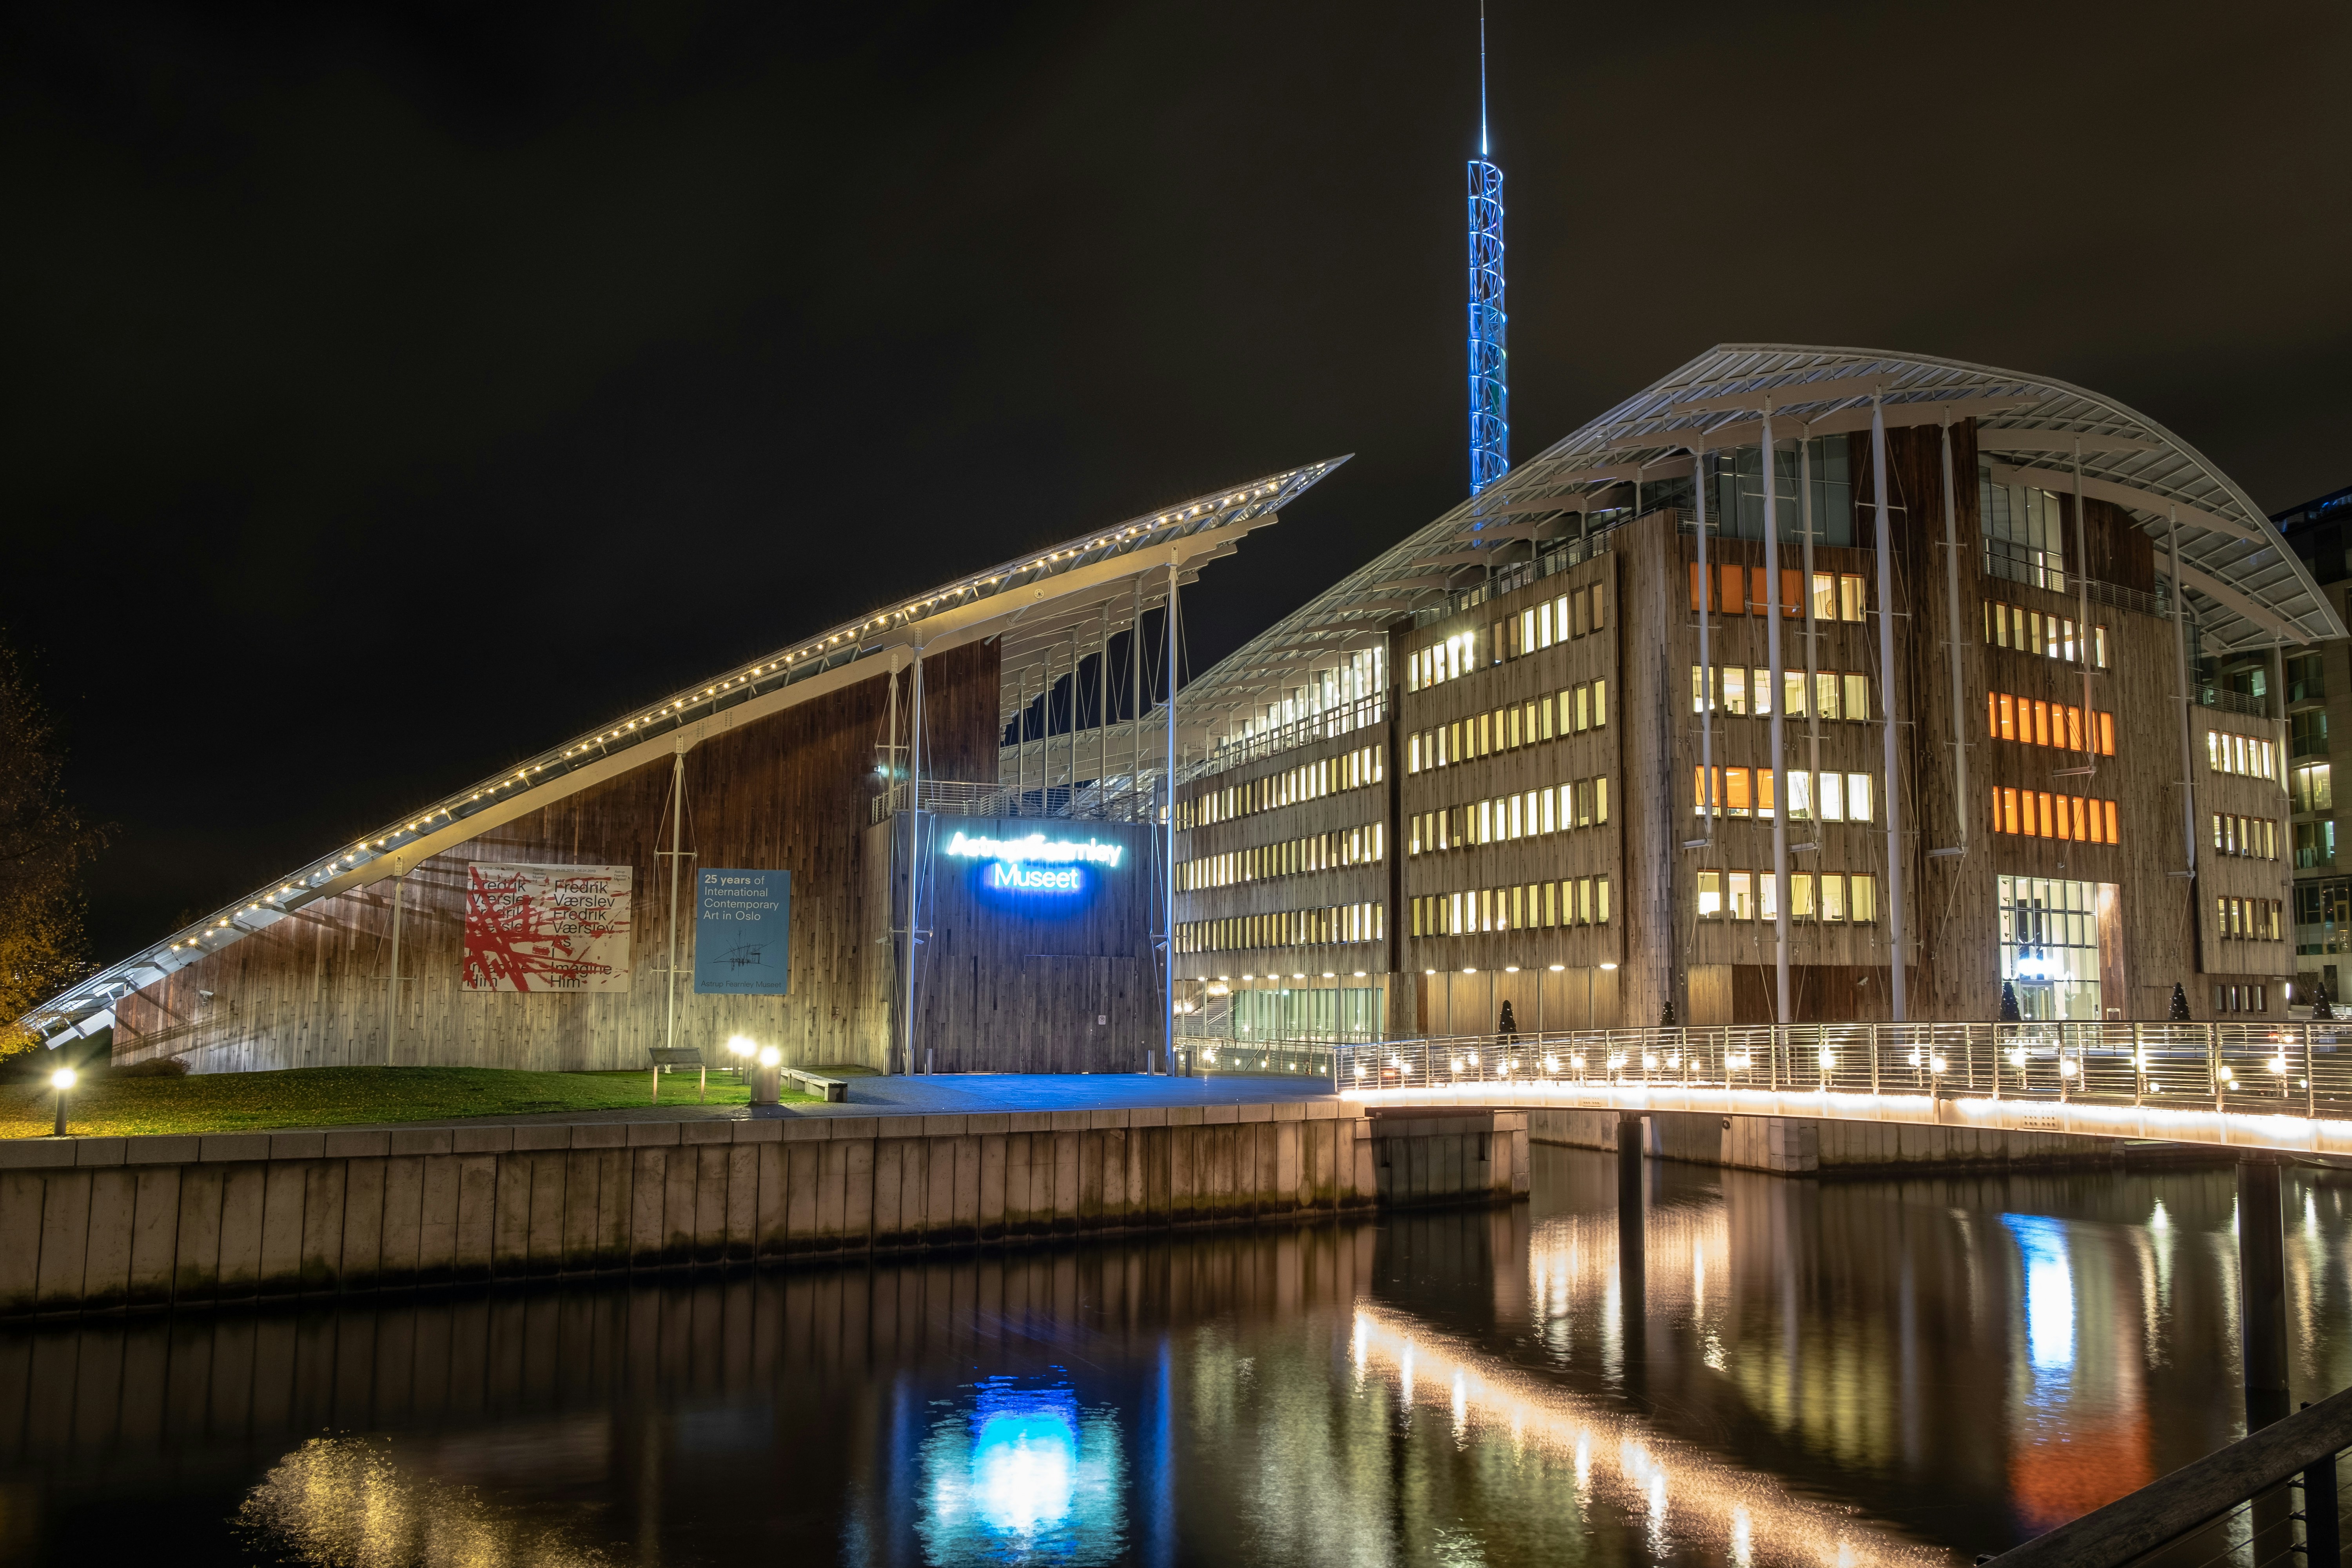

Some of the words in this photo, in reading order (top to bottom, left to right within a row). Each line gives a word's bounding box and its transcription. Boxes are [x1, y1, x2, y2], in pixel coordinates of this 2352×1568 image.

[704, 874, 717, 884] 25
[720, 877, 751, 886] years
[754, 876, 765, 885] of
[995, 864, 1078, 888] Museet
[555, 880, 608, 893] Fredrik
[704, 886, 768, 897] International
[554, 893, 615, 907] Værslev
[704, 898, 779, 911] Contemporary
[554, 907, 607, 920] Fredrik
[703, 910, 719, 920] Art
[723, 911, 731, 920] in
[735, 911, 760, 920] Oslo
[550, 975, 580, 988] Him
[726, 980, 754, 989] Fearnley
